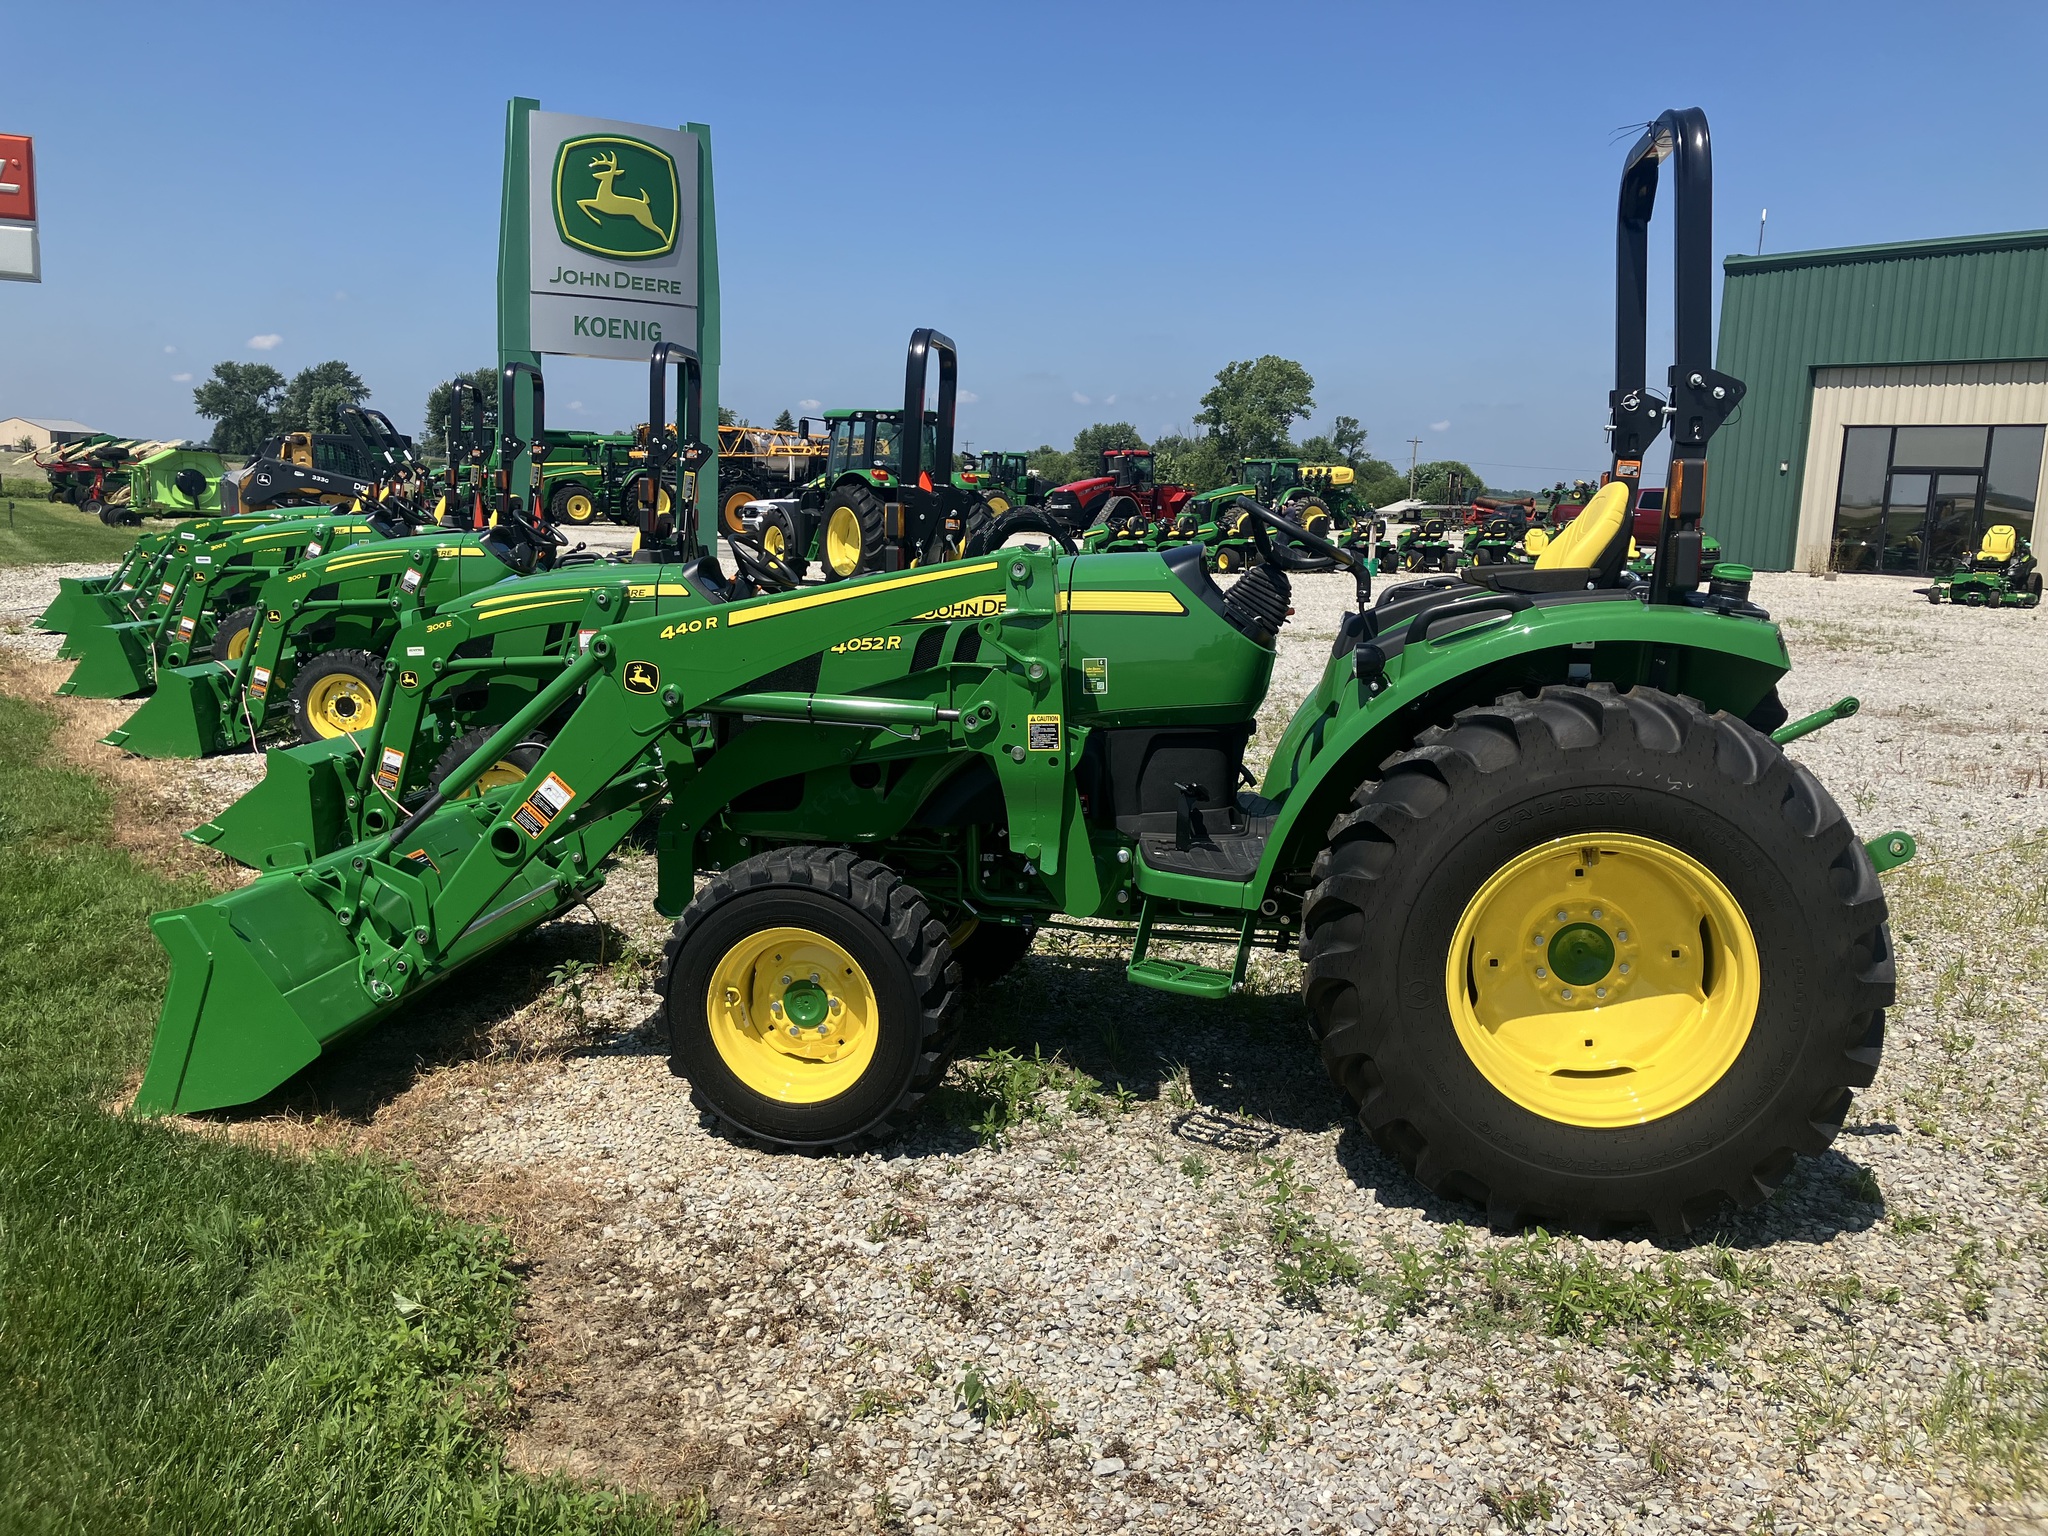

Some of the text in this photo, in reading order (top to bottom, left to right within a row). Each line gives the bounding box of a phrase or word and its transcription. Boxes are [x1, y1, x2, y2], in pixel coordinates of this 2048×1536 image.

[549, 266, 682, 294] JOHN DEERE
[573, 315, 662, 342] KOENIG
[287, 573, 302, 583] 300
[426, 622, 446, 633] 300
[660, 616, 719, 640] 440 R
[830, 636, 885, 655] 4052
[1493, 790, 1633, 833] GALAXY
